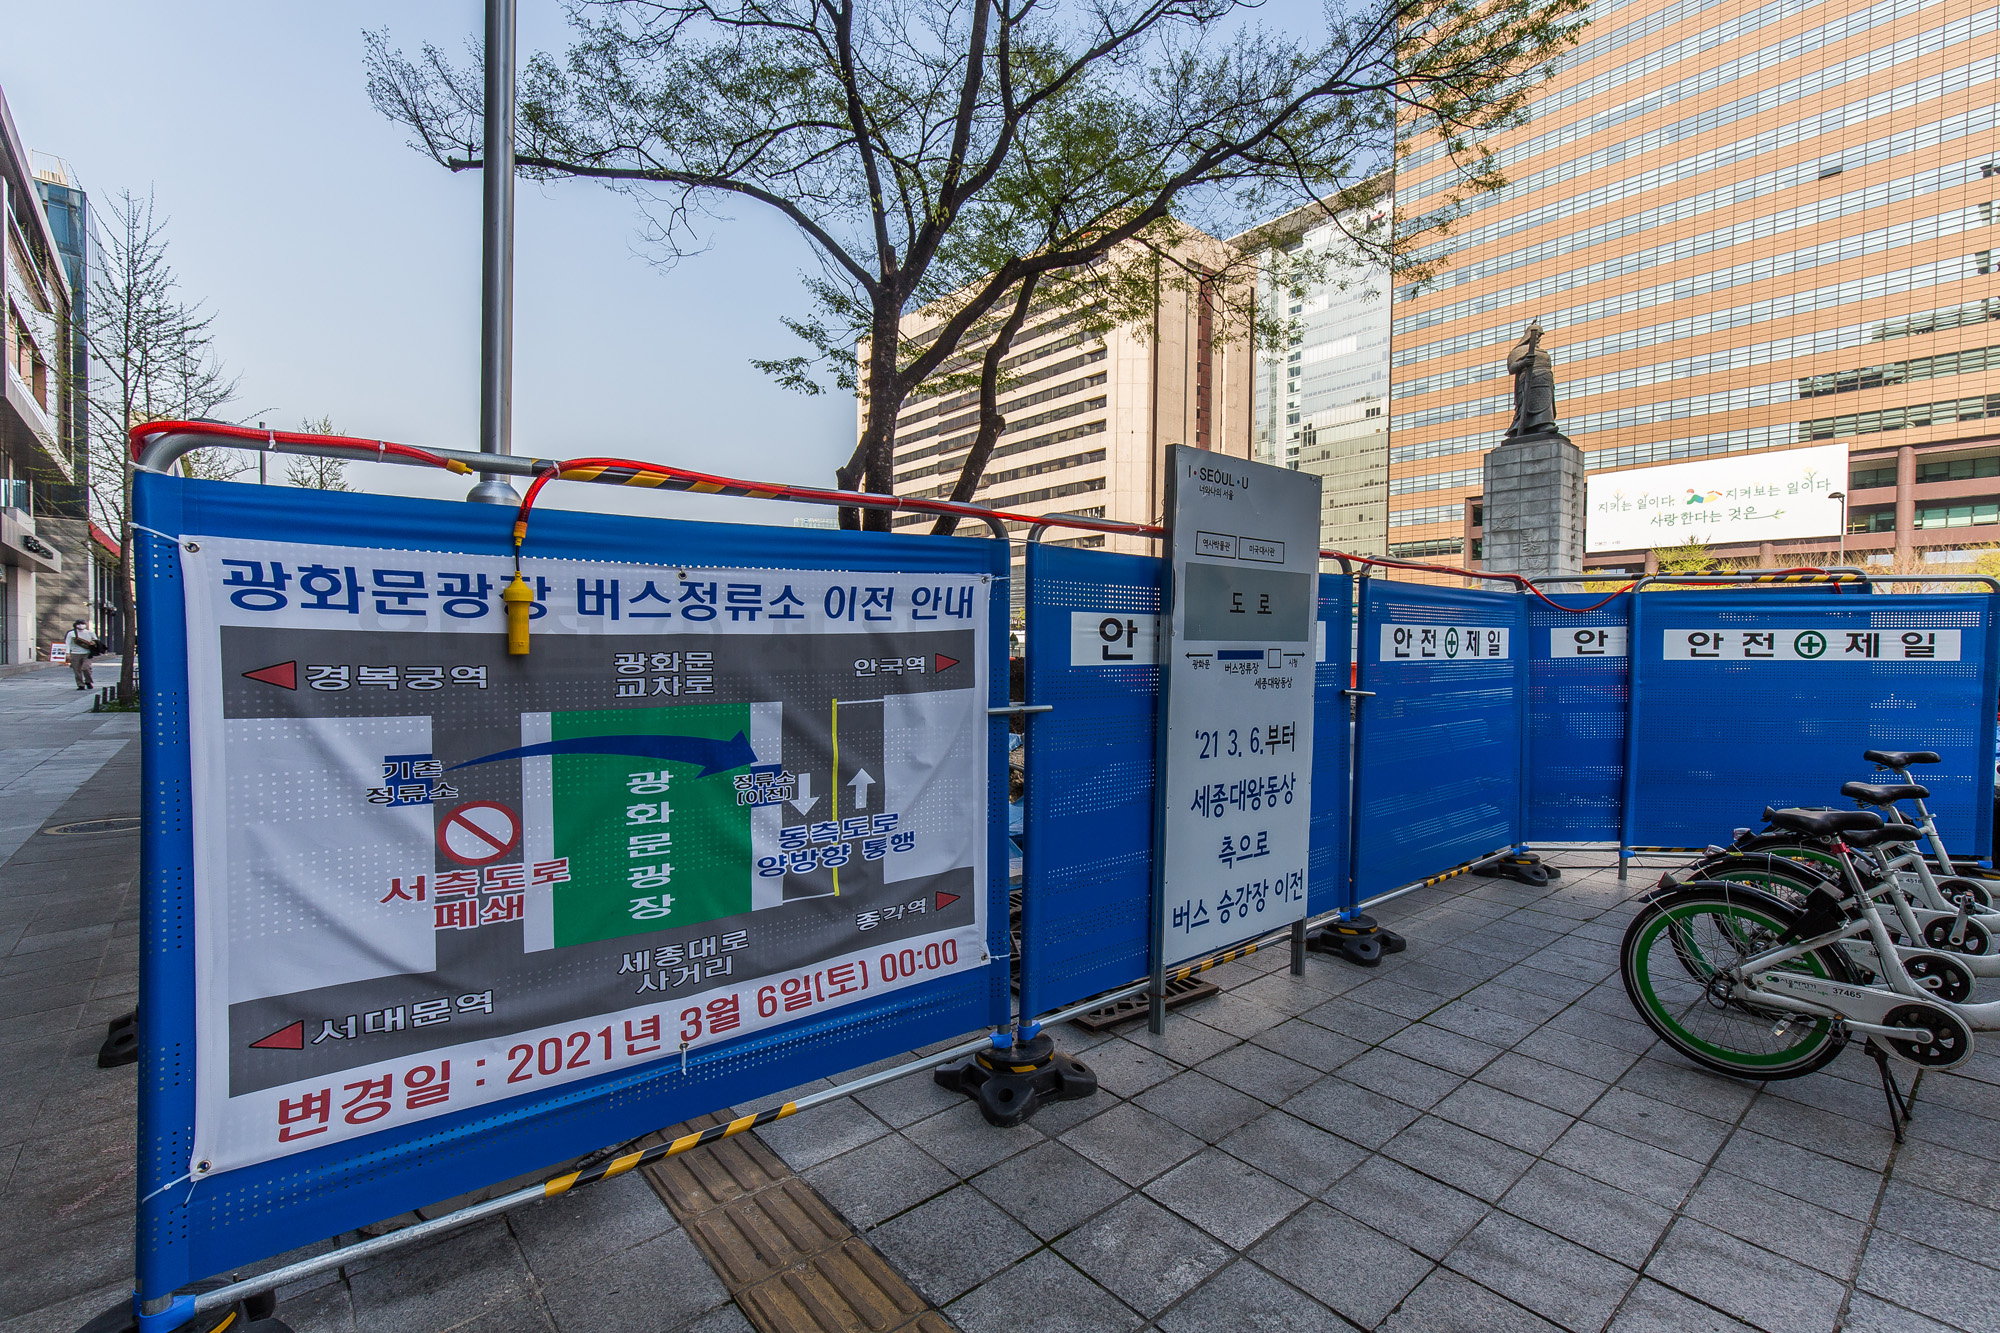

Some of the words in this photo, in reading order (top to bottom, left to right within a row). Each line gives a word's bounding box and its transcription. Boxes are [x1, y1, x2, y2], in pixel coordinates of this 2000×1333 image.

[1199, 485, 1222, 498] 너와나의
[1222, 489, 1234, 501] 서울
[1598, 491, 1632, 513] 지키는
[1728, 506, 1758, 521] 것은
[1202, 538, 1231, 552] 역사박물관
[1248, 544, 1276, 557] 미국대사관
[576, 577, 806, 622] 버스정류소
[823, 586, 896, 622] 이전
[910, 585, 975, 620] 안내
[1098, 617, 1138, 661] 안
[1573, 629, 1609, 655] 안
[613, 651, 715, 674] 광화문
[853, 656, 927, 678] 안국역
[1192, 659, 1211, 670] 광화문
[1224, 662, 1260, 675] 버스정류장
[1288, 658, 1298, 668] 시청
[304, 664, 489, 691] 경복궁역
[614, 675, 715, 700] 교차로
[1253, 676, 1293, 690] 세종대왕동상
[380, 759, 444, 781] 기존
[733, 770, 796, 790] 정류소
[365, 781, 460, 806] 정류소
[1190, 771, 1297, 819] 세종대왕동상
[777, 812, 901, 849] 동측도로
[756, 842, 852, 878] 양방향
[861, 831, 917, 862] 통행
[1218, 830, 1271, 869] 측으로
[379, 857, 572, 905] 서측도로
[432, 893, 526, 931] 폐쇄
[1172, 899, 1210, 934] 버스
[1216, 878, 1269, 924] 승강장
[1274, 868, 1304, 903] 이전
[854, 896, 928, 933] 종각역
[616, 928, 751, 976] 세종대로
[634, 954, 735, 996] 사거리
[1832, 986, 1862, 999] 37465
[310, 989, 495, 1046] 서대문역
[277, 1059, 452, 1143] 변경일
[506, 1014, 662, 1084] 2021년
[679, 993, 741, 1042] 3월
[756, 960, 869, 1019] 6일(토)
[880, 938, 959, 983] 00:00
